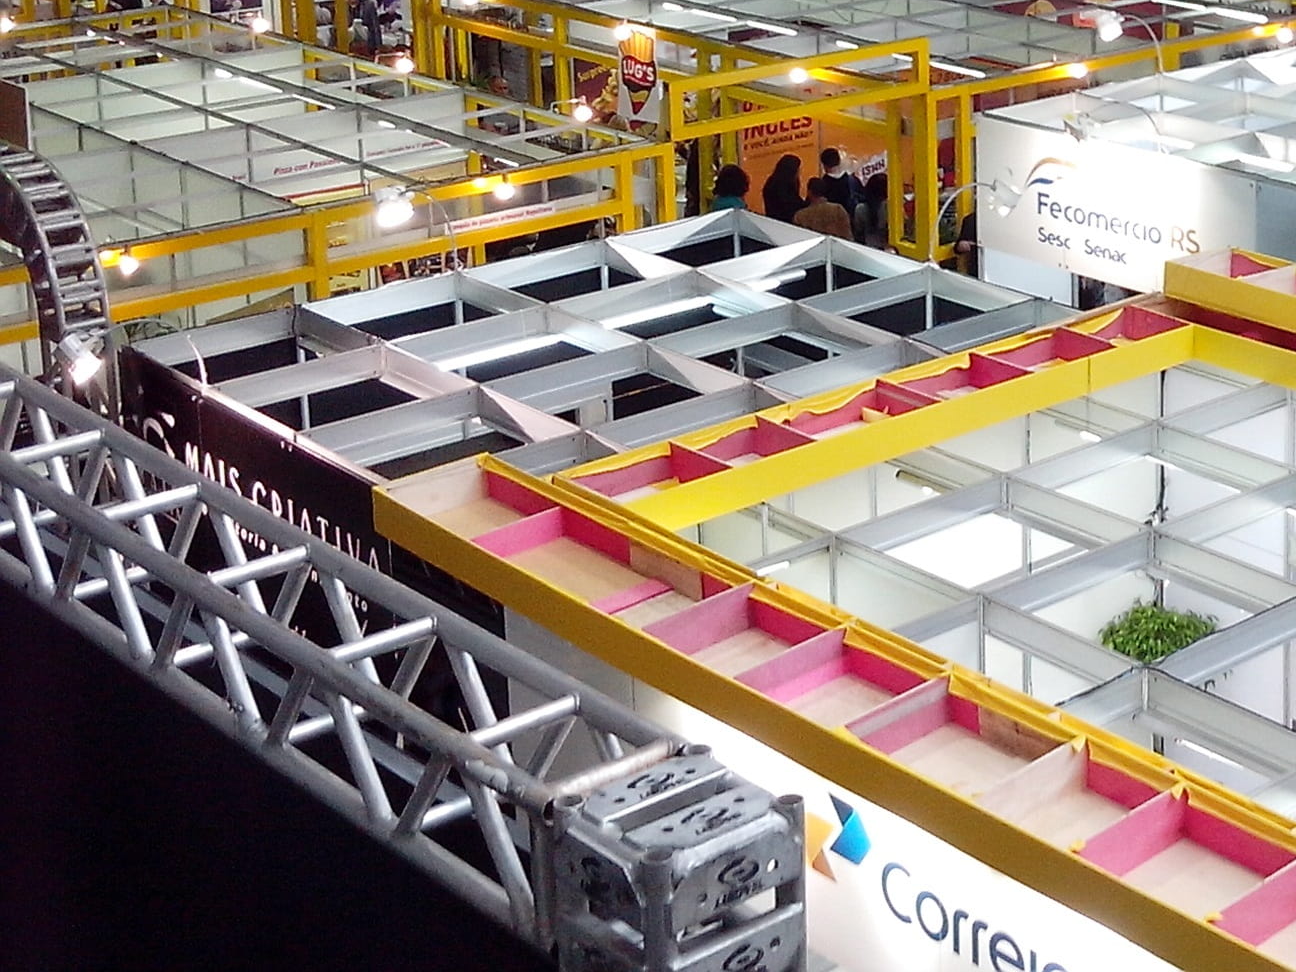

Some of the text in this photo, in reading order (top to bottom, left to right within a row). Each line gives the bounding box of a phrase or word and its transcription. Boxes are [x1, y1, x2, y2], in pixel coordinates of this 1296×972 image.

[622, 59, 654, 81] LUG'S
[1038, 226, 1128, 265] Sesc Senac
[1171, 225, 1201, 254] RS
